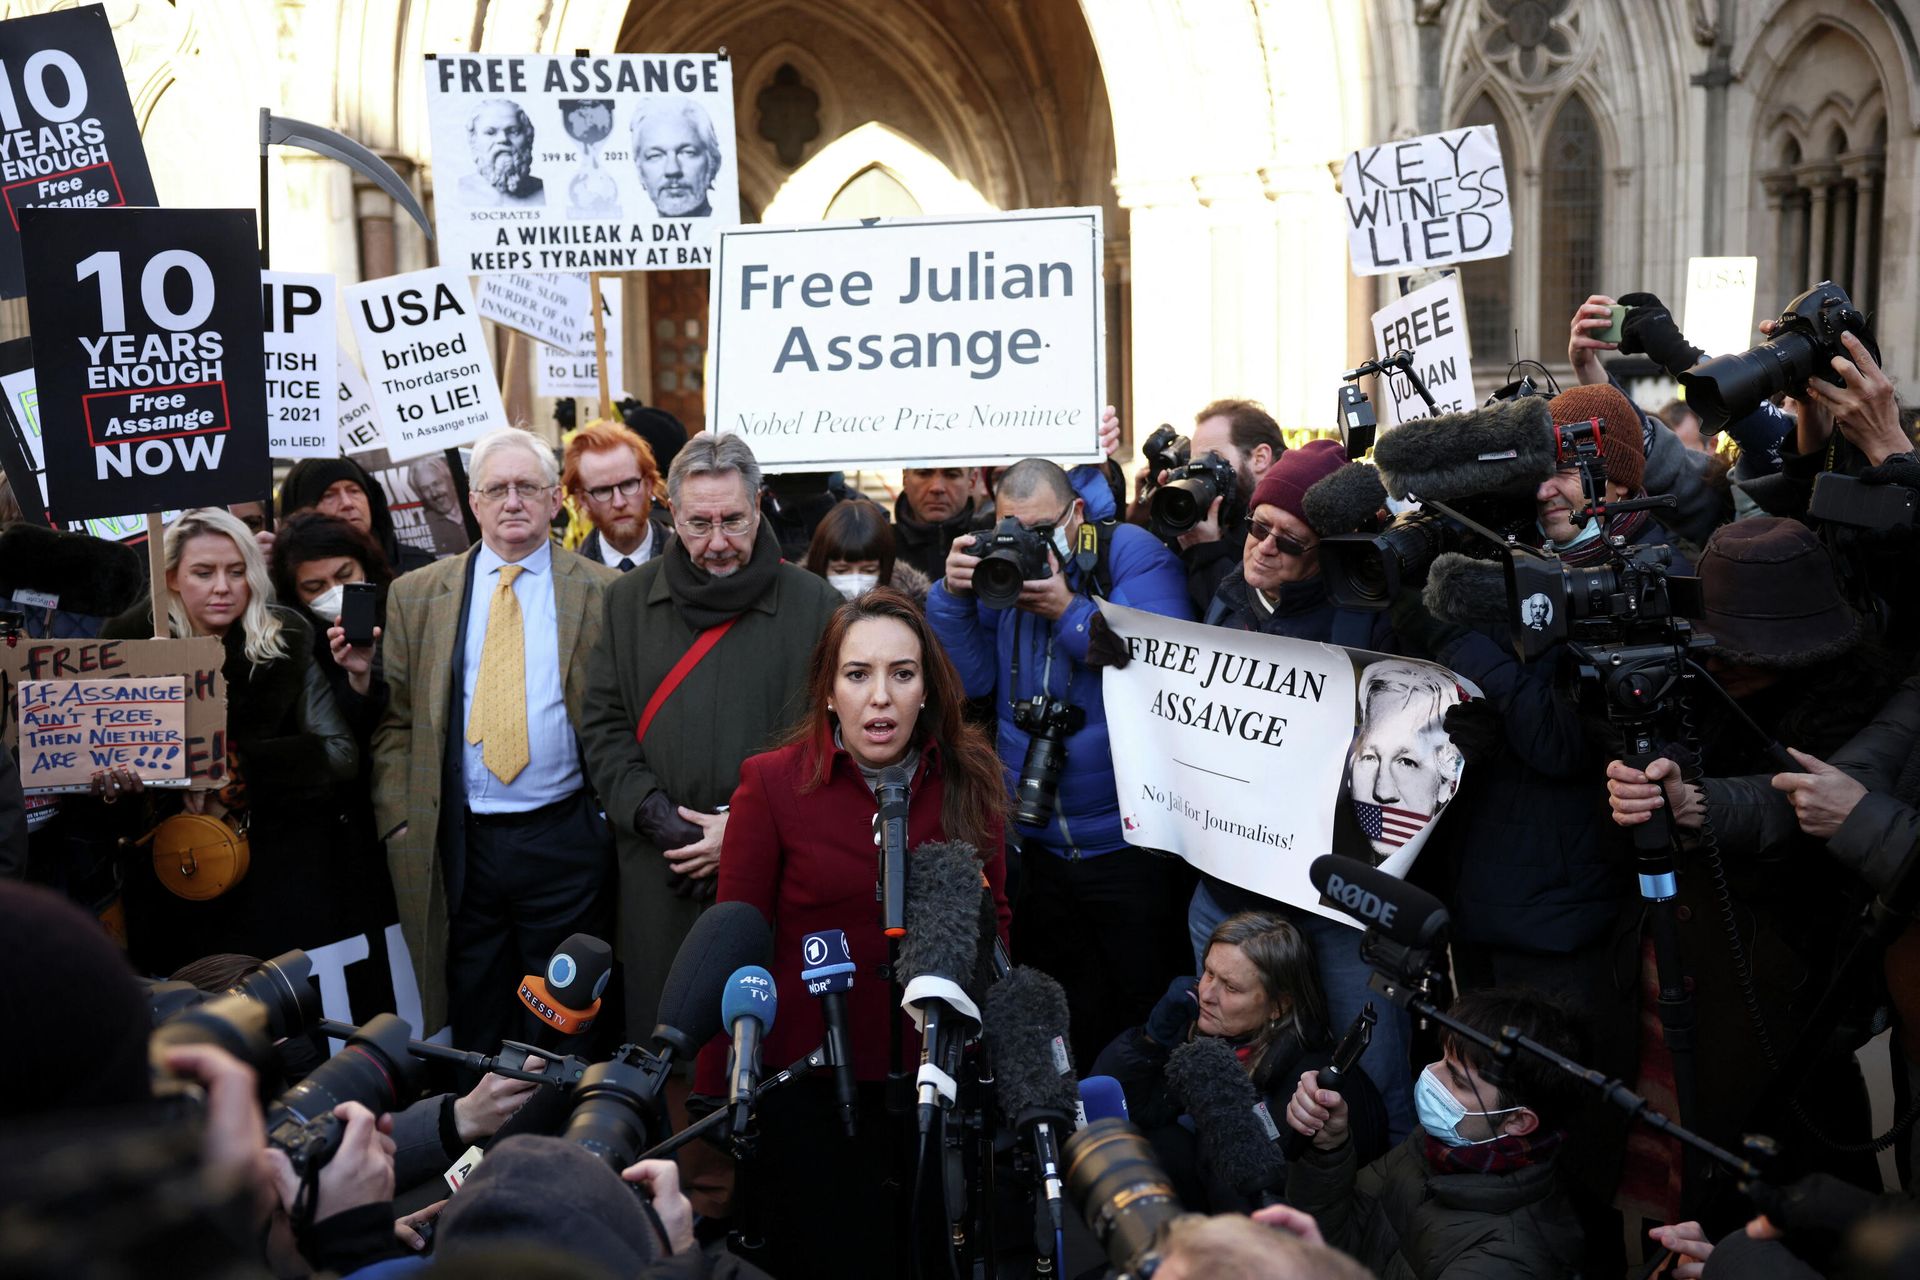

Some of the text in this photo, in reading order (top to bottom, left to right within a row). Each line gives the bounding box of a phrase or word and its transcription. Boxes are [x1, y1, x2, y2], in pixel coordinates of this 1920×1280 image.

[0, 49, 88, 131] 10
[438, 59, 719, 93] FREE ASSANGE
[0, 117, 105, 161] YEARS
[604, 151, 629, 161] 2021
[1, 143, 109, 182] ENOUGH
[1354, 130, 1473, 196] KEY
[38, 177, 83, 199] Free
[1346, 165, 1504, 230] WITNESS
[470, 210, 541, 221] SOCRATES
[496, 223, 693, 246] A WIKILEAK A DAY
[1367, 211, 1493, 268] LIED
[470, 247, 712, 270] KEEPS TYRANNY AT BAY
[76, 249, 216, 333] 10
[537, 287, 569, 307] SLOW
[740, 250, 1074, 310] Free Julian
[361, 282, 466, 333] USA
[485, 281, 537, 311] MURDER
[542, 306, 557, 319] OF
[480, 297, 544, 331] INNOCENT
[550, 326, 573, 344] MAN
[1382, 296, 1454, 358] FREE
[78, 331, 224, 366] YEARS
[382, 332, 467, 370] bribed
[772, 326, 1042, 380] Assange
[87, 360, 223, 389] ENOUGH
[382, 363, 481, 394] Thordarson
[549, 363, 566, 378] to
[129, 393, 186, 414] Free
[280, 407, 320, 422] 2021
[396, 384, 481, 423] to LIE!
[733, 404, 1081, 437] Nobel Peace Prize Nominee
[104, 409, 215, 437] Assange
[402, 411, 489, 441] In Assange trial
[94, 434, 226, 480] NOW
[291, 436, 326, 447] LIED!
[20, 641, 126, 679] FREE
[1125, 636, 1327, 703] FREE JULIAN
[58, 682, 184, 707] ASSANGE
[24, 708, 162, 726] AIN'T FREE,
[1150, 688, 1288, 748] ASSANGE
[25, 729, 184, 748] THEN NIETHER
[31, 752, 78, 774] ARE
[1141, 784, 1295, 850] No Jail for Journalists!
[1326, 873, 1399, 930] RØDE
[740, 976, 768, 986] AFP
[750, 988, 769, 1002] TV
[808, 979, 828, 995] NDR
